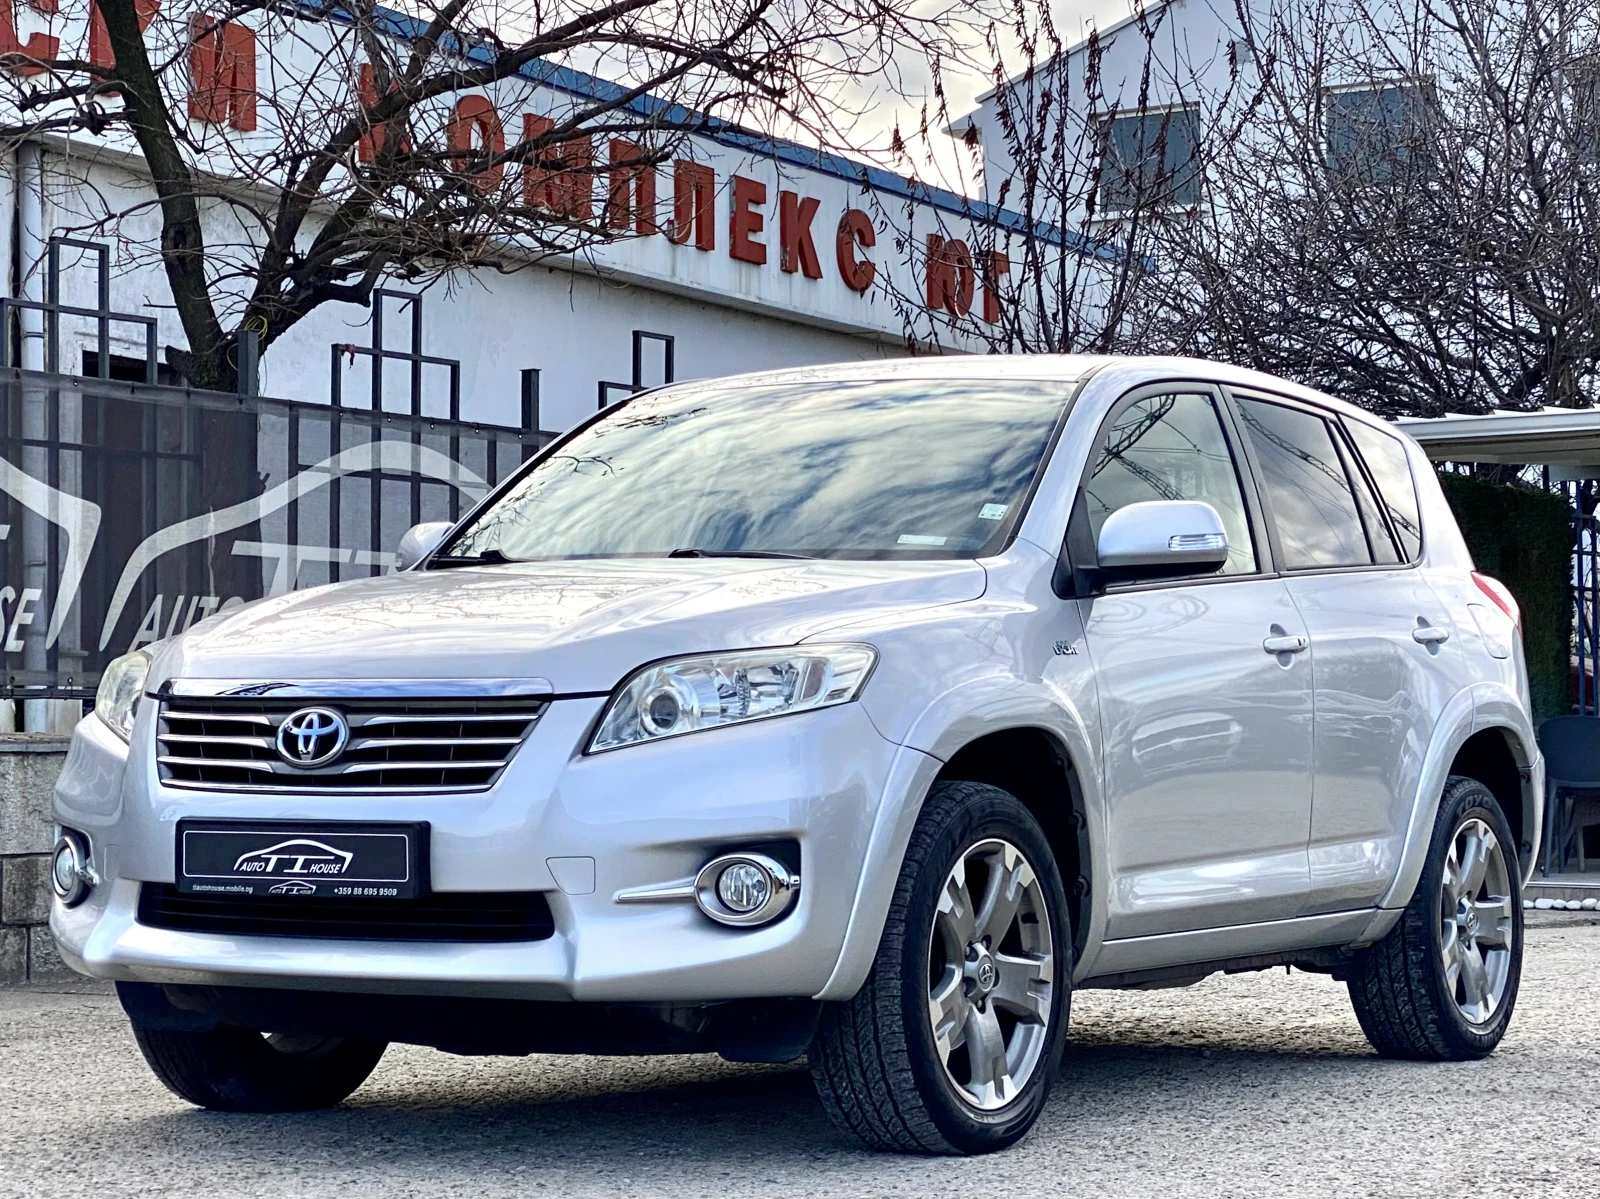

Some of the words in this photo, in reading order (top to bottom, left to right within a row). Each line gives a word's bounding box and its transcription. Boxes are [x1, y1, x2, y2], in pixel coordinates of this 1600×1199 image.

[926, 233, 1010, 323] ЮГ
[127, 594, 245, 654] AUT
[239, 861, 265, 872] AUTO
[260, 854, 335, 873] TI
[309, 863, 341, 874] HOUSE
[333, 887, 352, 895] +359
[353, 887, 362, 895] 88
[364, 887, 378, 896] 695
[379, 888, 398, 896] 9509
